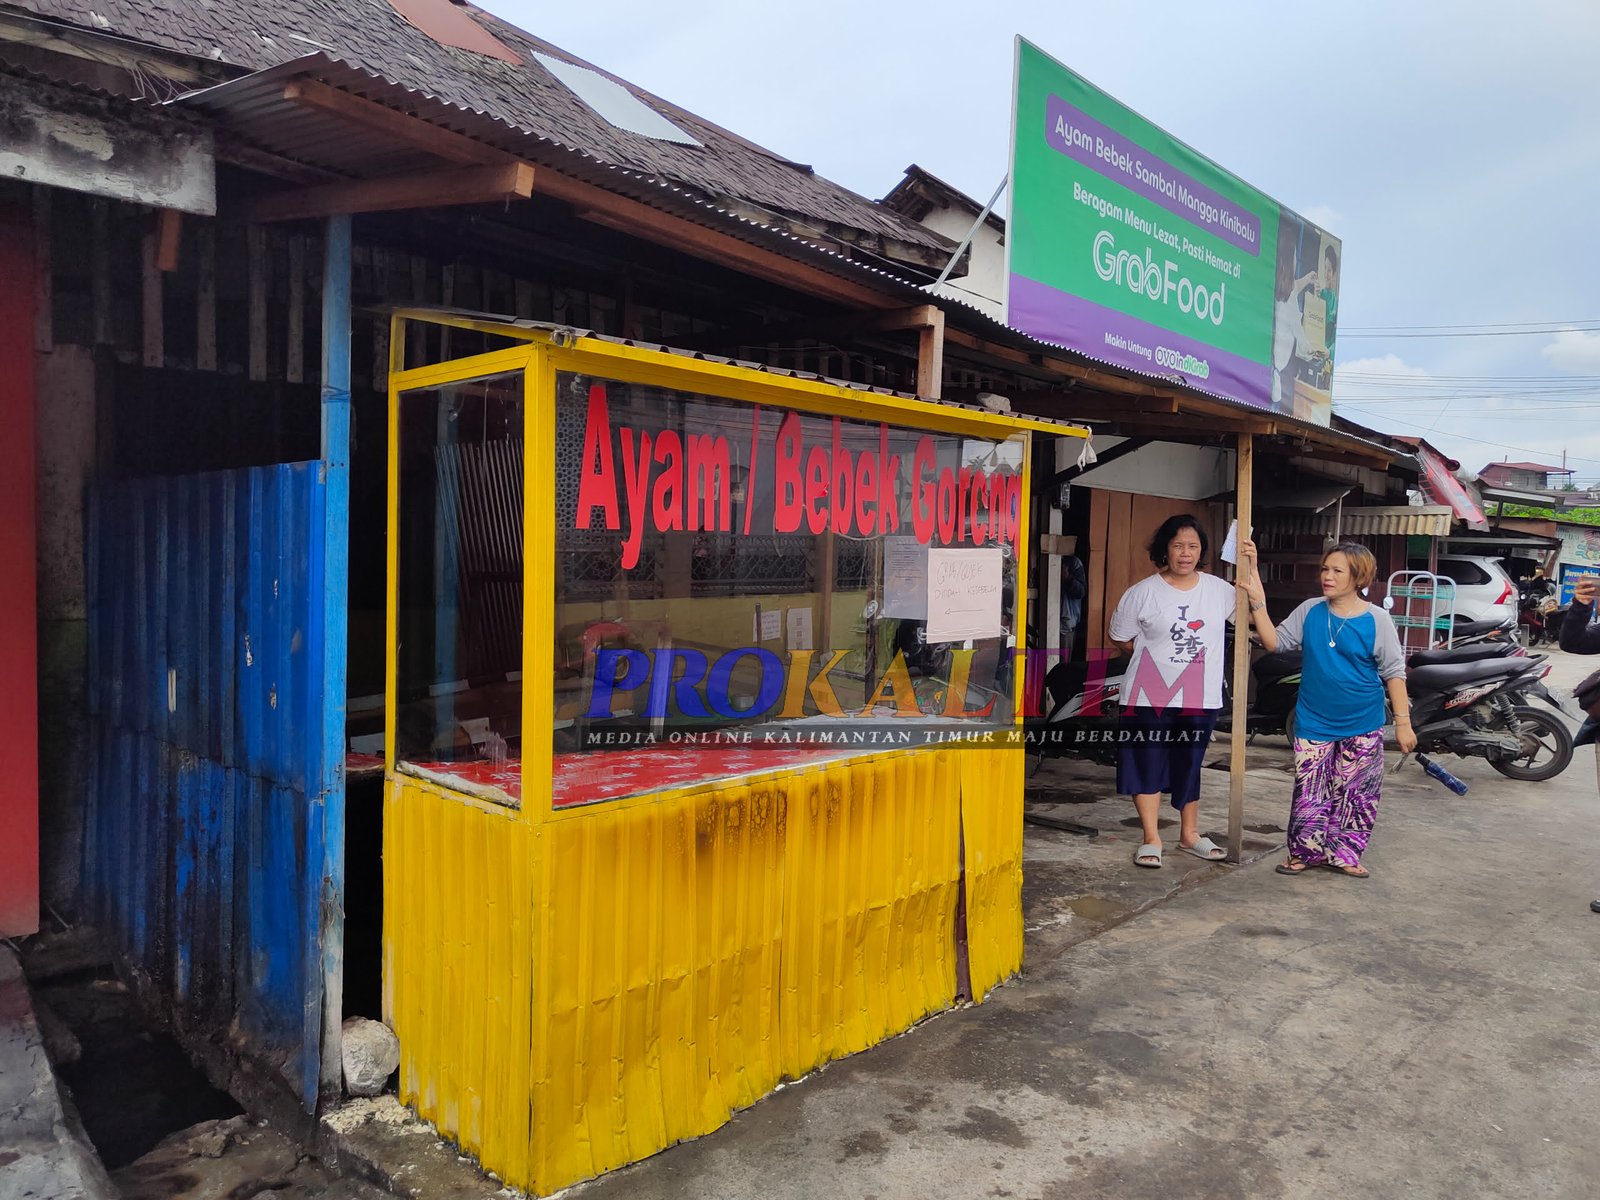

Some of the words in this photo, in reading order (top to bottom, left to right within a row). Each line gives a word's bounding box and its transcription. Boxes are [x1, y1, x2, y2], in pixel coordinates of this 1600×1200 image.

[1055, 114, 1093, 153] Ayam
[1095, 137, 1134, 177] Bebek
[1135, 160, 1177, 200] Sambal
[1178, 185, 1219, 224] Mangga
[1219, 208, 1256, 243] Kinibalu
[1073, 181, 1123, 222] Beragam
[1124, 208, 1152, 236] Menu
[1153, 222, 1181, 253] Lezat,
[1182, 237, 1204, 262] Pasti
[1205, 248, 1232, 275] Hemat
[1232, 263, 1241, 279] di
[1092, 230, 1226, 326] GrabFood
[1104, 331, 1127, 350] Makin
[1127, 339, 1153, 361] Untung
[575, 385, 731, 570] Ayam
[744, 403, 760, 535] /
[774, 411, 900, 536] Bebek
[911, 434, 1022, 562] Goreng
[1168, 656, 1205, 665] Taiwan
[1177, 604, 1190, 621] I
